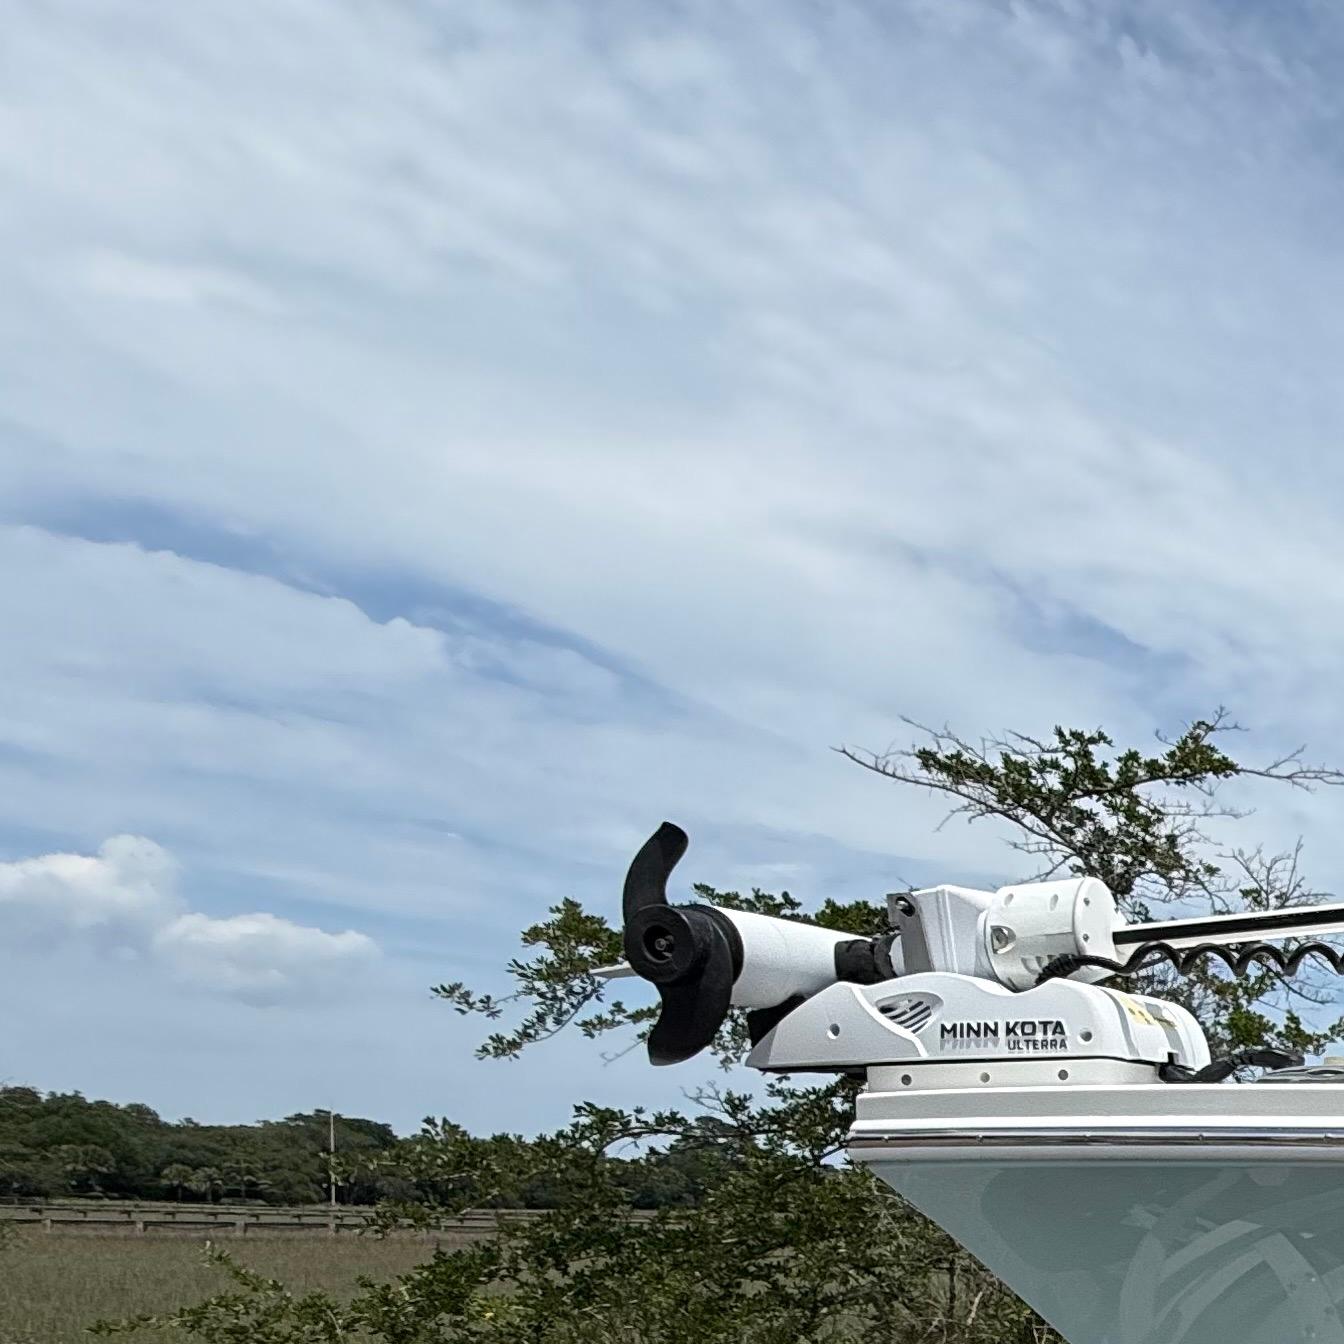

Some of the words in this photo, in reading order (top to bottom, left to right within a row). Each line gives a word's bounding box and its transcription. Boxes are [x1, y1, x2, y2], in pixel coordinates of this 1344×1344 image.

[940, 1021, 999, 1039] MINN
[1006, 1020, 1066, 1037] KOTA
[1008, 1038, 1068, 1051] ULTERRA
